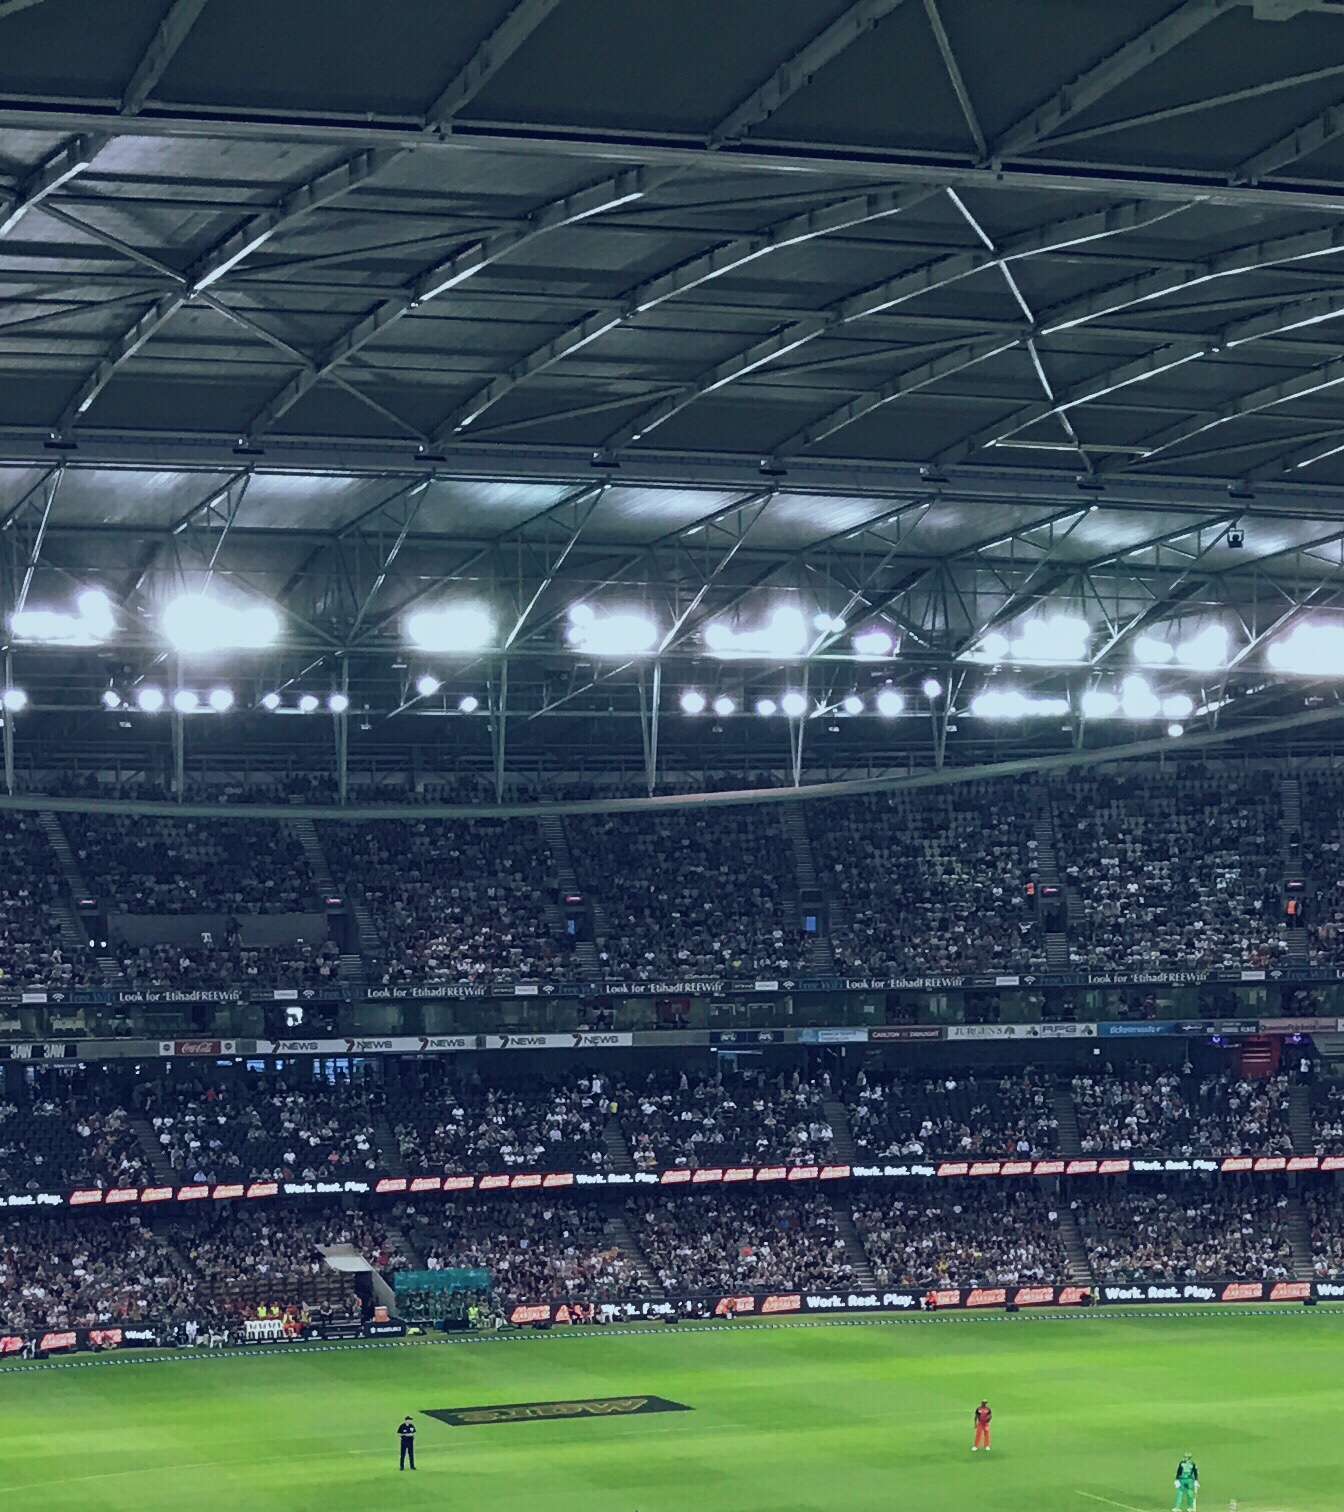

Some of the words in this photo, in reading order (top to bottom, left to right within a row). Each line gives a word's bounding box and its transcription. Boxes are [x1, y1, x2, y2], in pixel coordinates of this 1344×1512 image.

[1105, 1287, 1145, 1299] Work.
[1148, 1287, 1181, 1298] Rest.
[1185, 1286, 1215, 1300] Play.
[807, 1295, 845, 1307] Work.
[848, 1295, 880, 1306] Rest.
[884, 1294, 915, 1307] Play.
